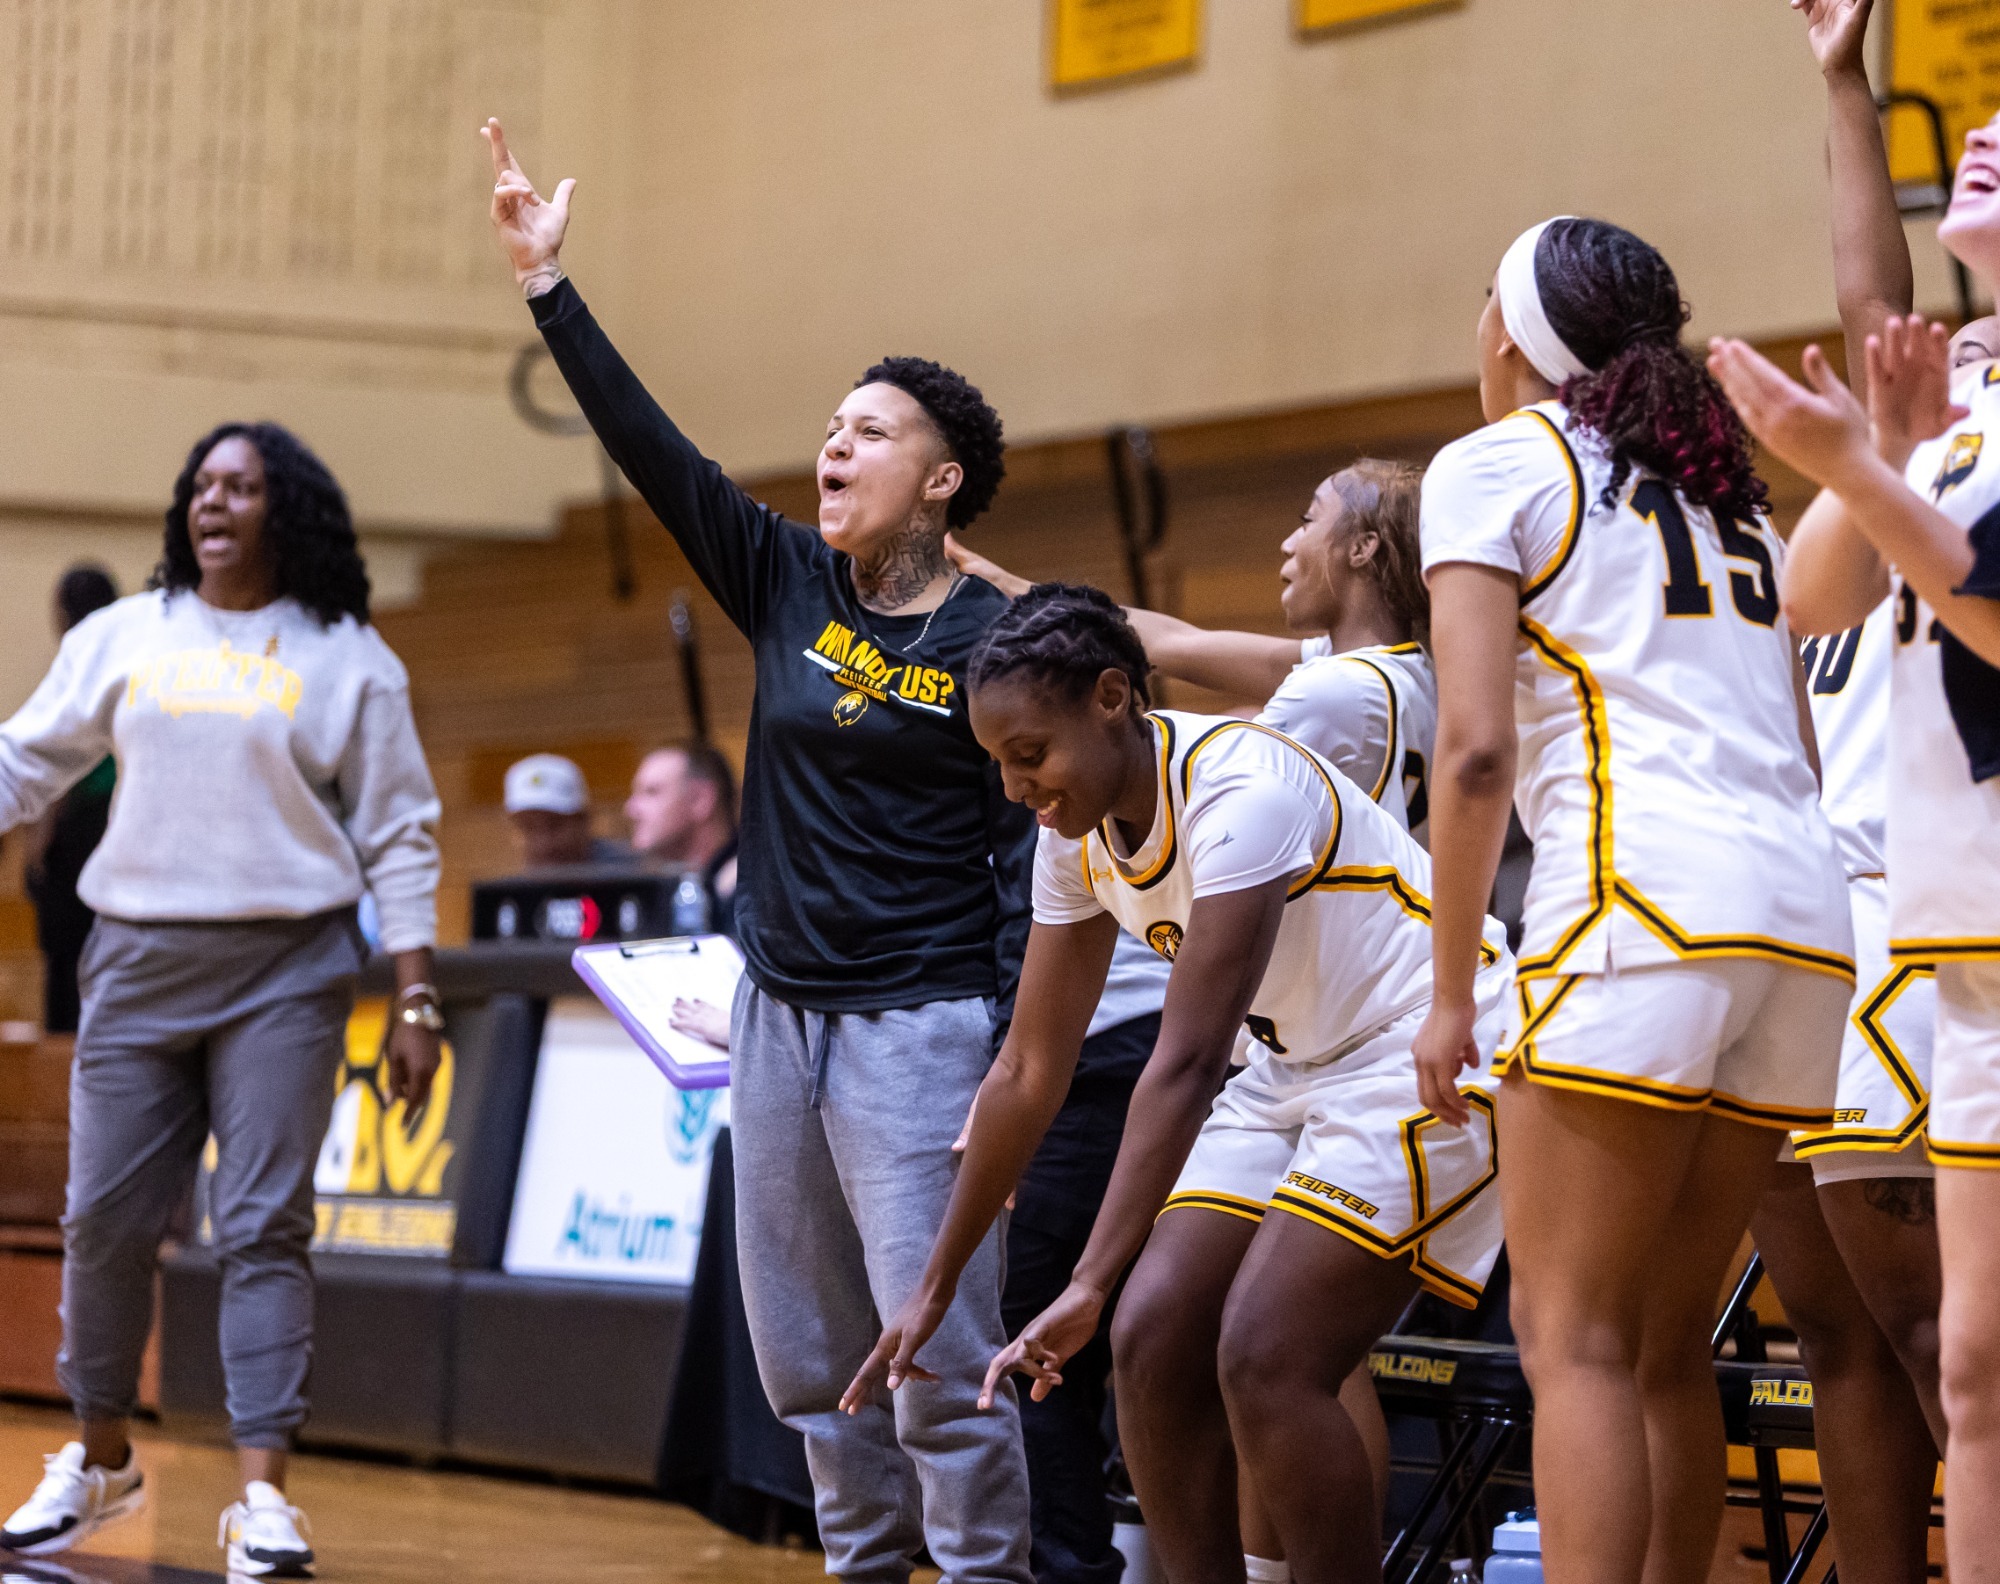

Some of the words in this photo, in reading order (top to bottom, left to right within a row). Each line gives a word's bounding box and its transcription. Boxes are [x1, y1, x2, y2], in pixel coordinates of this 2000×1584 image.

[1628, 480, 1780, 628] 15
[846, 640, 902, 684] NOT
[899, 665, 955, 705] US?
[1749, 1379, 1814, 1408] FALCO
